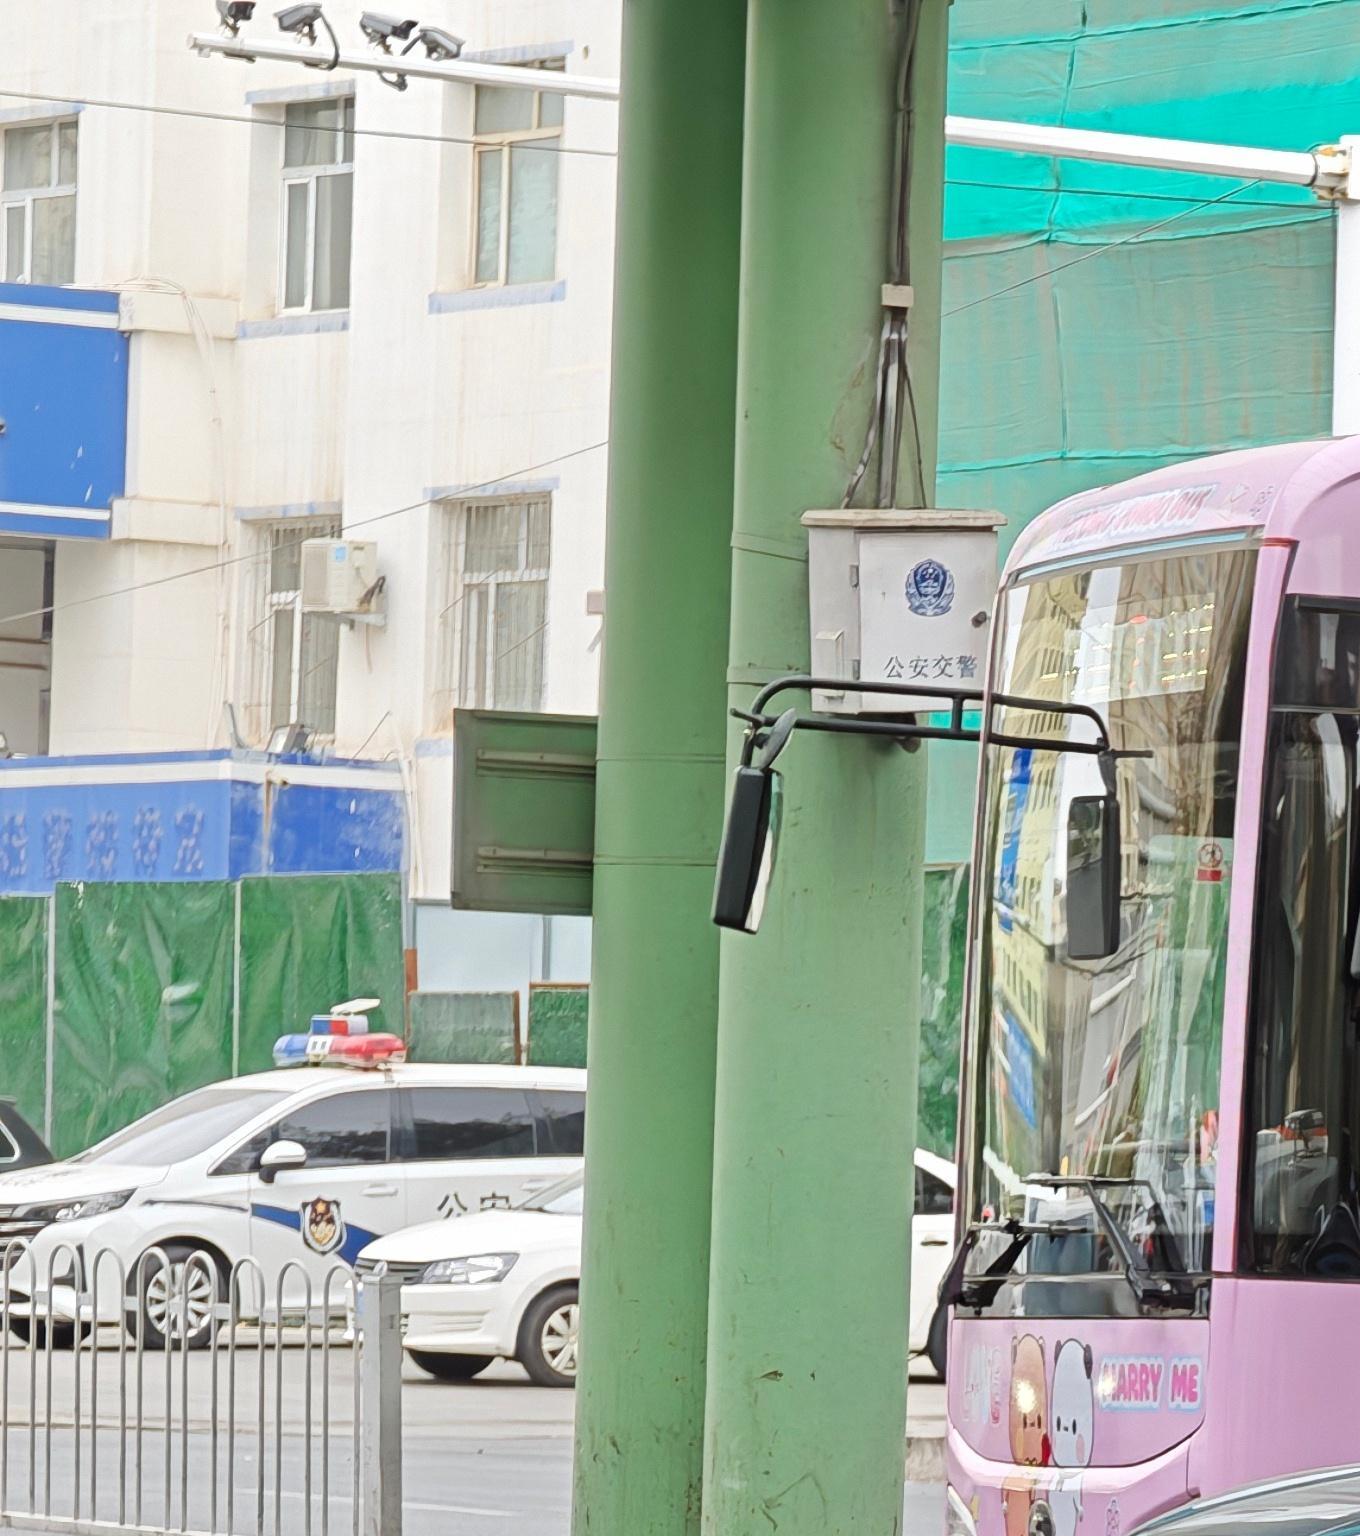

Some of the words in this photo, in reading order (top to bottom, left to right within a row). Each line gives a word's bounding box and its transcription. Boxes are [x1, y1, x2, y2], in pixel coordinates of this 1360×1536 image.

[884, 654, 978, 679] 公安交警
[1171, 1364, 1200, 1403] ME
